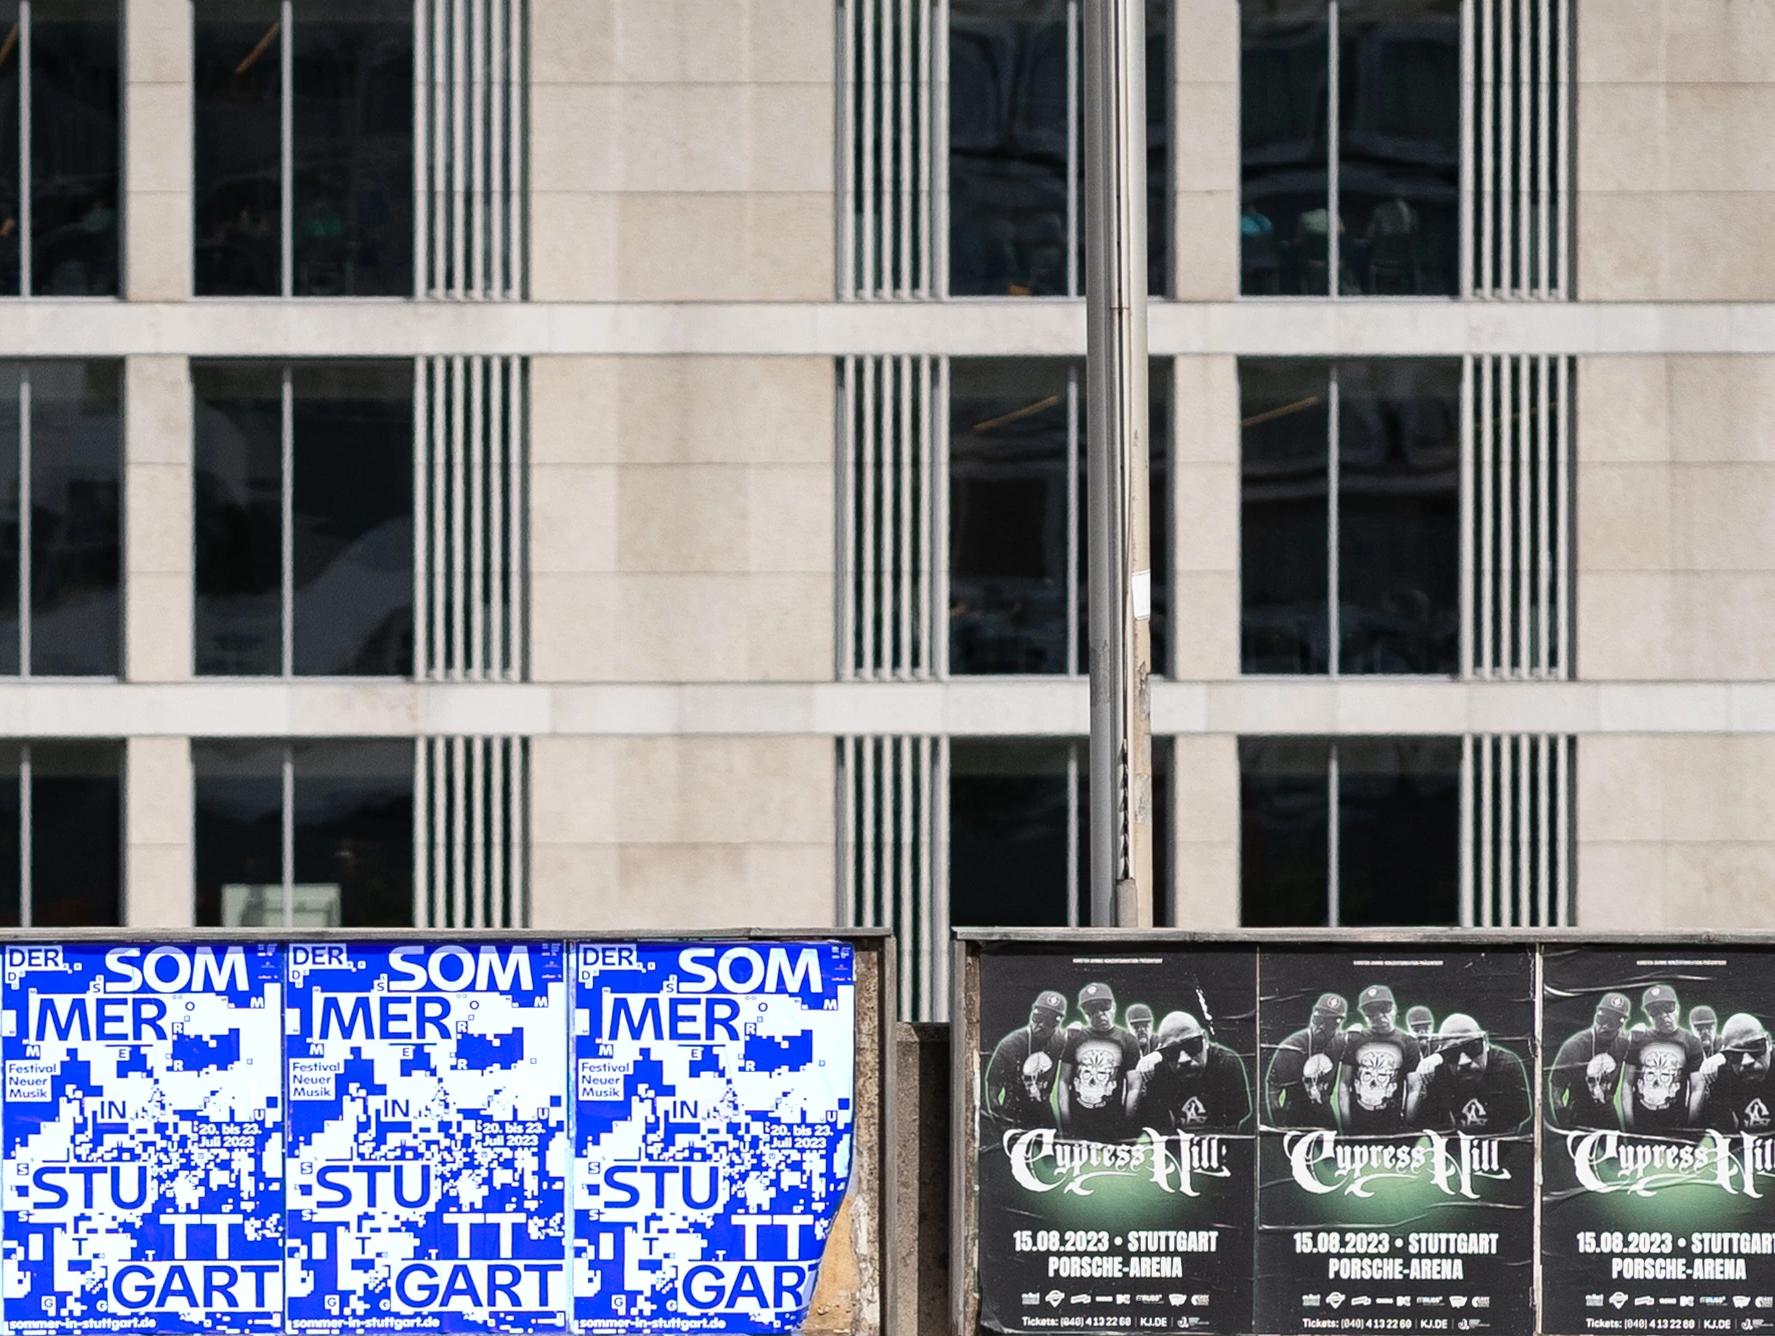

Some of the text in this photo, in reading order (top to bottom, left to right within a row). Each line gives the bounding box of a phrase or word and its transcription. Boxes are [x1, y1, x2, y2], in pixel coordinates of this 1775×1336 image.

[9, 948, 60, 967] DER
[293, 947, 344, 965] DER
[583, 947, 634, 966] DER
[105, 947, 249, 993] SOM
[389, 945, 533, 991] SOM
[678, 947, 823, 993] SOM
[37, 997, 168, 1041] MER
[320, 995, 452, 1039] MER
[610, 996, 741, 1040] MER
[9, 1063, 57, 1073] Festival
[293, 1062, 341, 1072] Festival
[582, 1062, 630, 1072] Festival
[9, 1076, 48, 1086] Neuer
[293, 1074, 331, 1084] Neuer
[582, 1075, 620, 1085] Neuer
[9, 1088, 48, 1098] Musik
[293, 1087, 331, 1096] Musik
[581, 1087, 620, 1097] Musik
[101, 1101, 125, 1119] IN
[384, 1099, 409, 1118] IN
[673, 1101, 697, 1119] IN
[199, 1124, 262, 1134] 20. bis 23.
[483, 1123, 545, 1133] 20. bis 23.
[771, 1125, 833, 1135] 20. bis 23.
[198, 1136, 255, 1146] Juli 2023
[482, 1135, 538, 1145] Juli 2023
[770, 1137, 826, 1148] Juli 2023
[1003, 1127, 1231, 1196] Cypress Hill
[1284, 1129, 1511, 1199] Cypress Hill
[1567, 1129, 1775, 1198] Cypress Hil
[32, 1166, 148, 1209] STU
[315, 1164, 431, 1208] STU
[603, 1165, 719, 1209] STU
[160, 1214, 243, 1259] TT
[443, 1213, 526, 1259] TT
[730, 1215, 813, 1260] TT
[1013, 1230, 1218, 1252] 15.08.2023 STUTTGART
[1293, 1232, 1499, 1254] 15.08.2023 STUTTGART
[1576, 1232, 1673, 1253] 15.08.2023
[1048, 1256, 1183, 1278] PORSCHE-ARENA
[1328, 1258, 1463, 1279] PORSCHE-ARENA
[1612, 1258, 1746, 1279] PORSCHE-ARENA
[112, 1264, 280, 1310] GART
[395, 1263, 563, 1309] GART
[682, 1264, 817, 1310] GAR
[10, 1317, 156, 1330] sommer-in-stuttgart.de
[293, 1316, 439, 1329] sommer-in-stuttgart.de
[580, 1317, 726, 1330] sommer-in-stuttgart.de
[1022, 1316, 1058, 1326] Tickets:
[1140, 1317, 1167, 1327] KJ.DE
[1302, 1318, 1338, 1328] Tickets:
[1421, 1319, 1448, 1329] KJ.DE
[1585, 1318, 1621, 1329] Tickets:
[1704, 1319, 1731, 1329] KJ.DE
